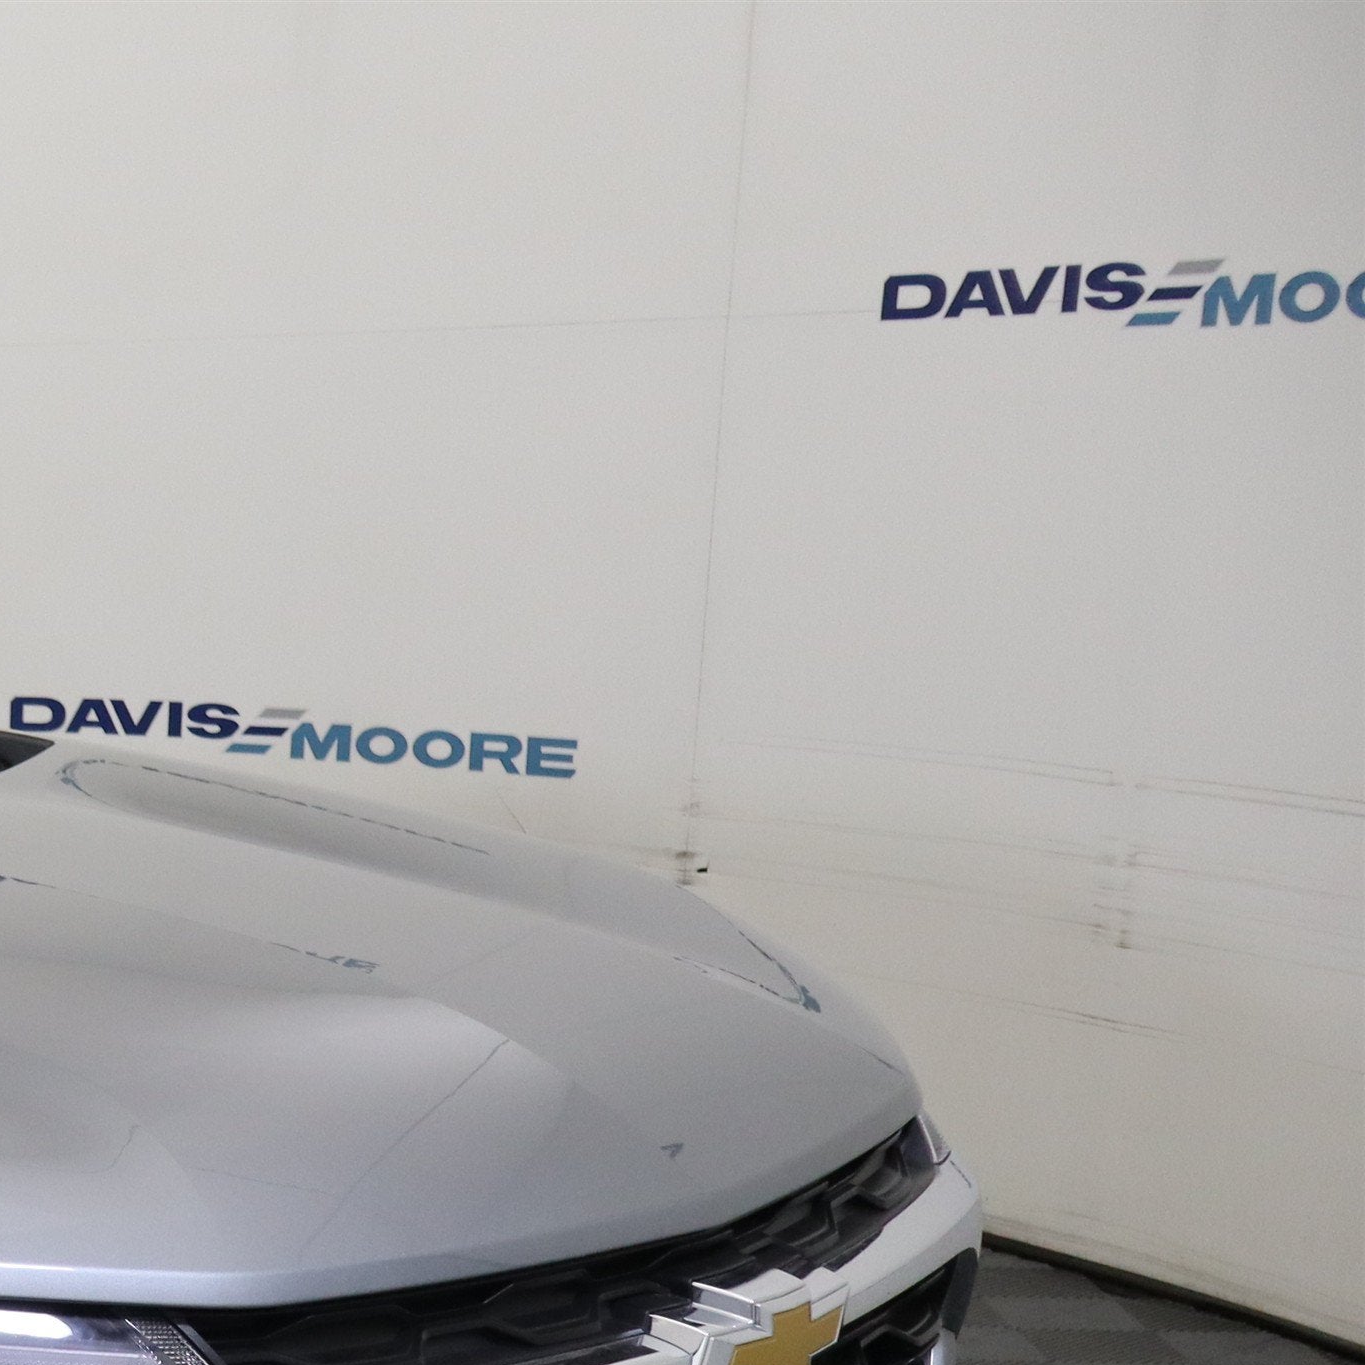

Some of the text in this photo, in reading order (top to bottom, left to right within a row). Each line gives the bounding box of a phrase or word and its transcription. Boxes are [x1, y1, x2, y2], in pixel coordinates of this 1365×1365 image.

[880, 262, 1146, 321] DAVIS
[10, 697, 577, 778] DAVIS MOORE
